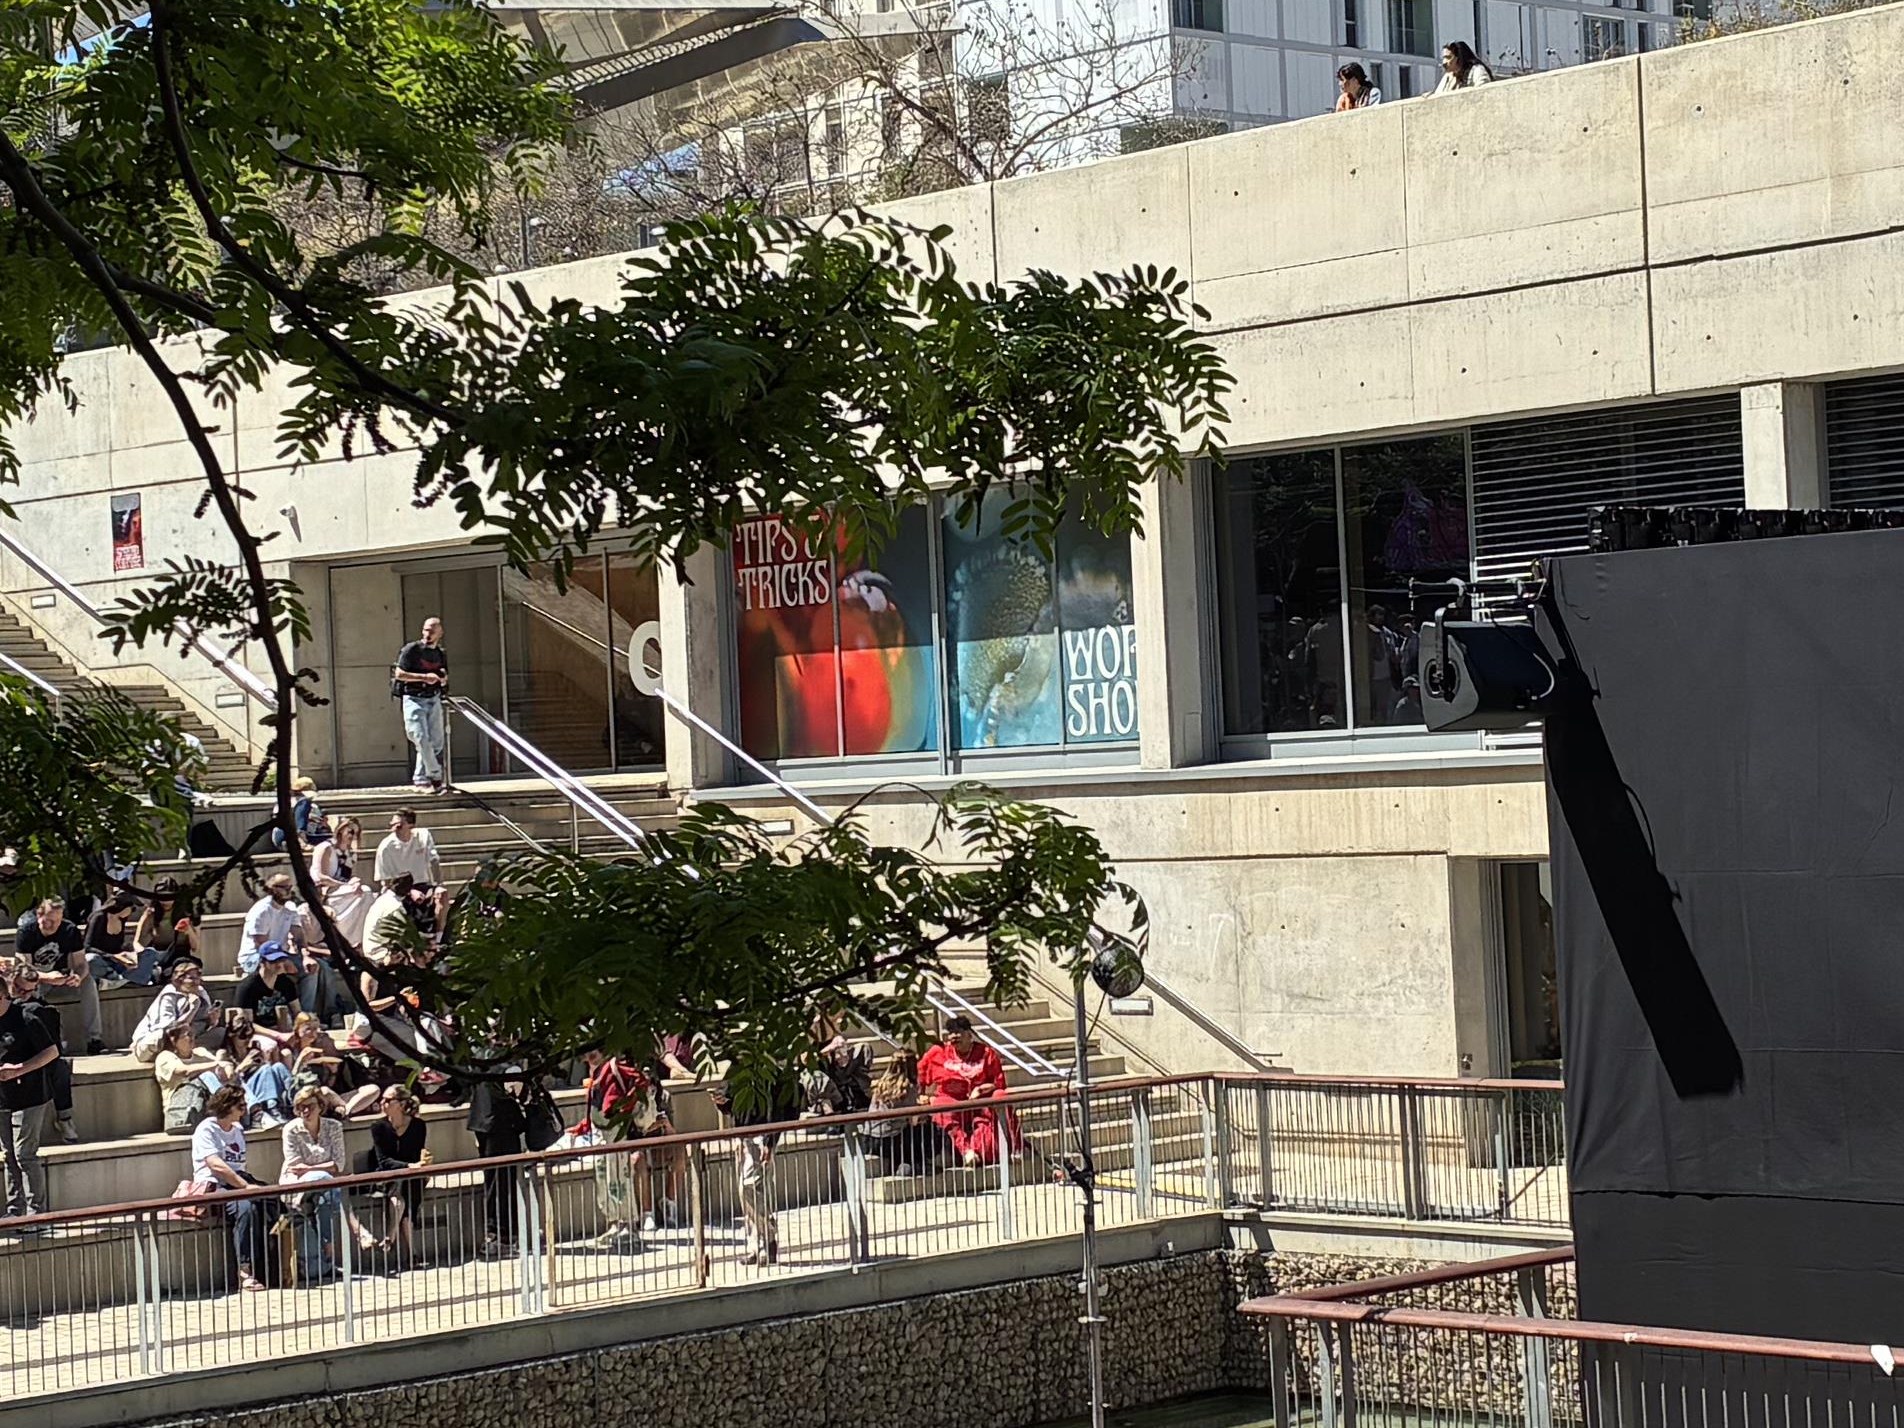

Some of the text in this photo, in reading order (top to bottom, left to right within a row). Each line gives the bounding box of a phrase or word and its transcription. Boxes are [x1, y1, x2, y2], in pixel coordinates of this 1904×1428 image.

[736, 519, 797, 565] TIPS
[737, 559, 830, 610] TRICKS
[1067, 680, 1140, 737] SHO
